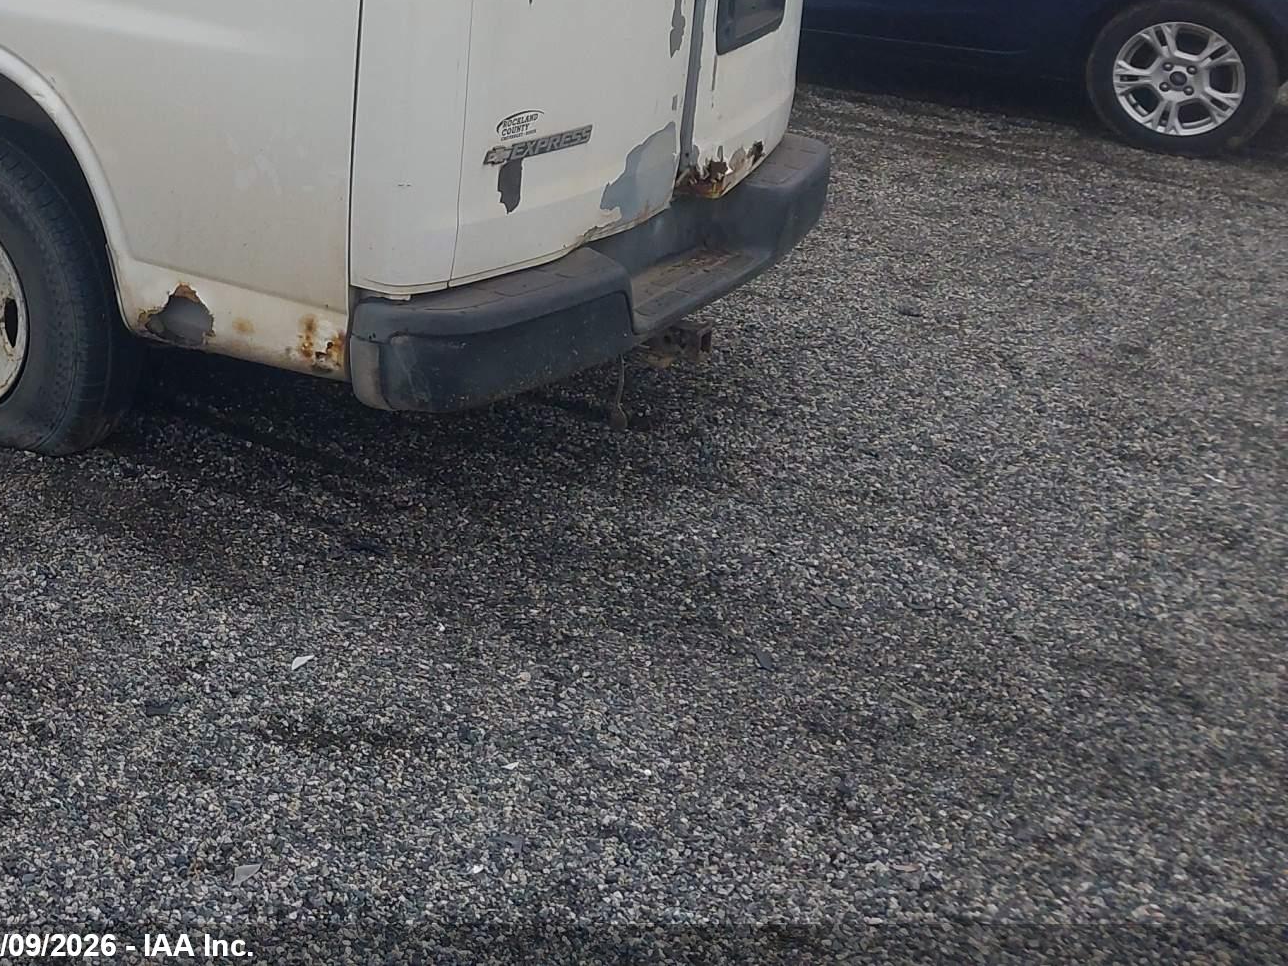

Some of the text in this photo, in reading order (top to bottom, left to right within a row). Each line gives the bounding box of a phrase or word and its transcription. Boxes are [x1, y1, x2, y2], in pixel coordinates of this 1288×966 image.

[502, 113, 539, 128] ROCKLAND
[501, 123, 530, 136] COUNTY
[509, 126, 592, 160] EXPRESS
